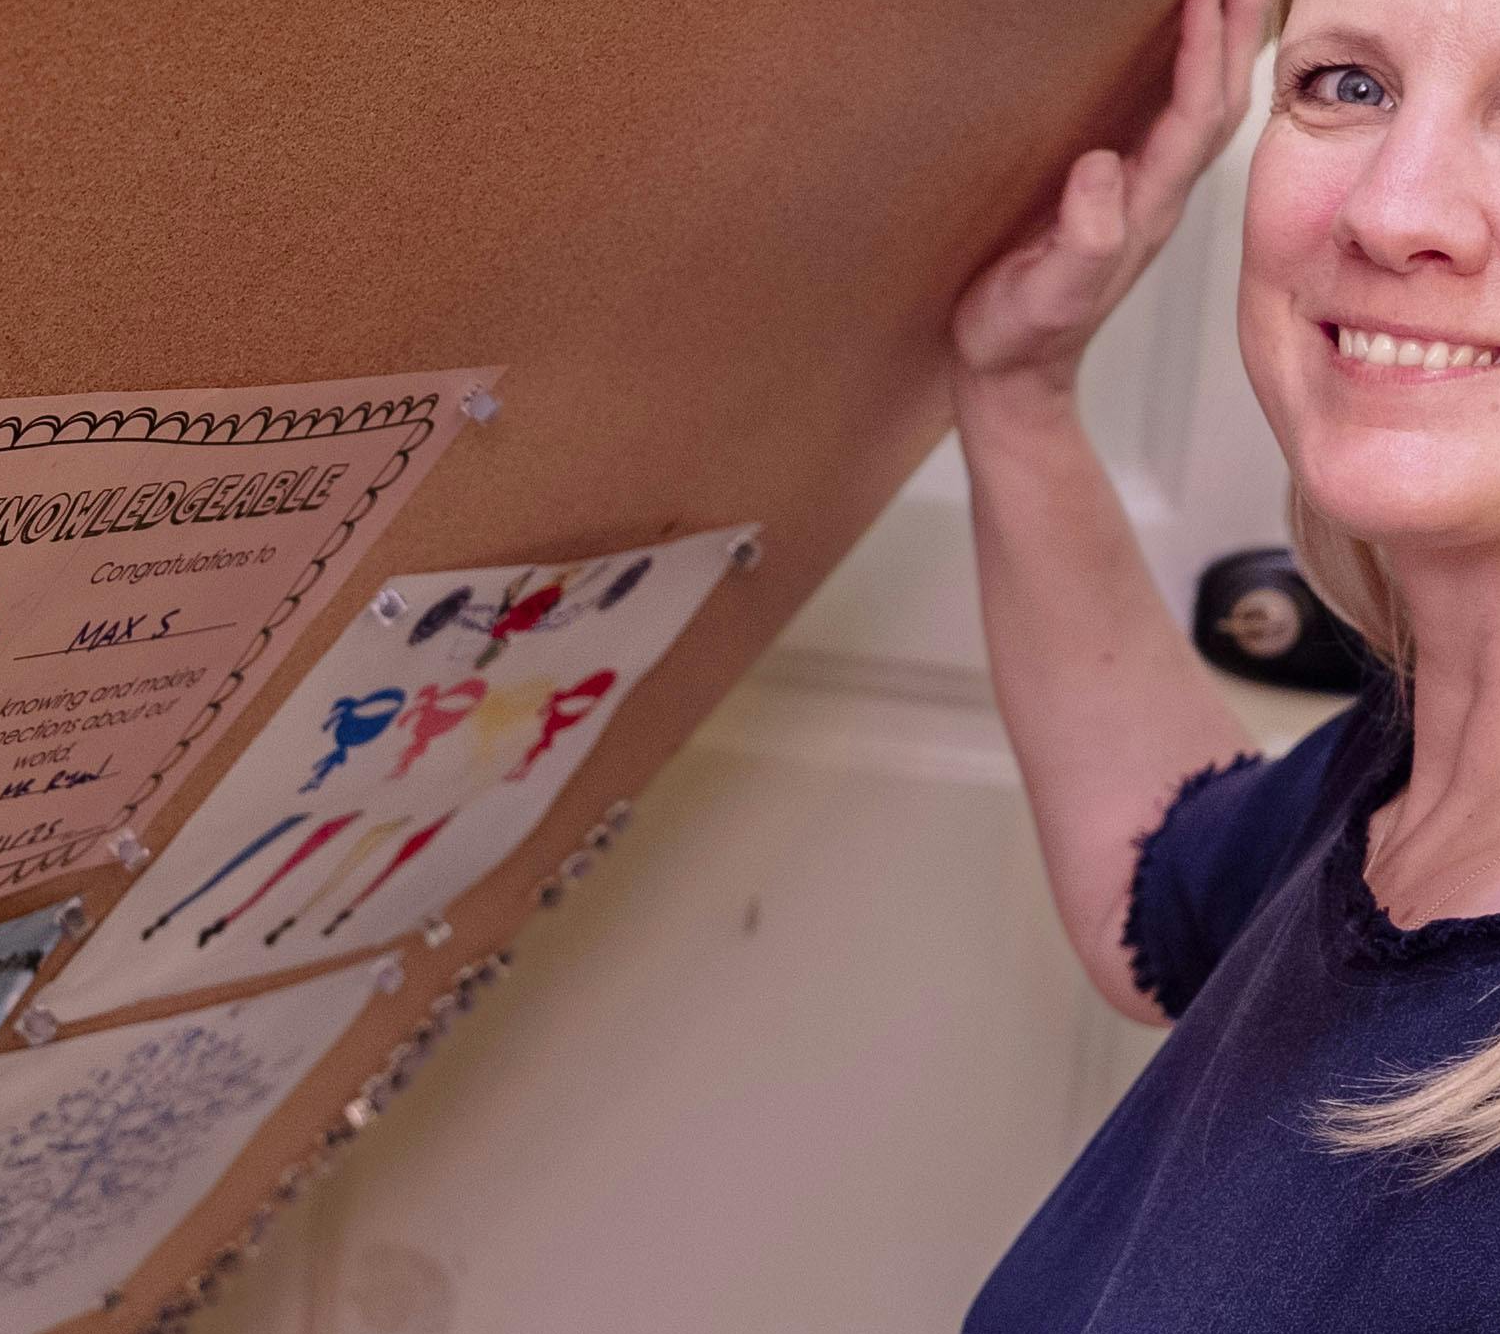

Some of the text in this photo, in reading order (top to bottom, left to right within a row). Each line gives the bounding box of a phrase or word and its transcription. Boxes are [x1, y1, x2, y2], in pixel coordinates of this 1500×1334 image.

[91, 543, 277, 585] Congratulations to
[65, 608, 182, 653] MAX S
[89, 677, 139, 704] and
[133, 666, 208, 696] making
[82, 700, 147, 731] about
[145, 696, 182, 718] our
